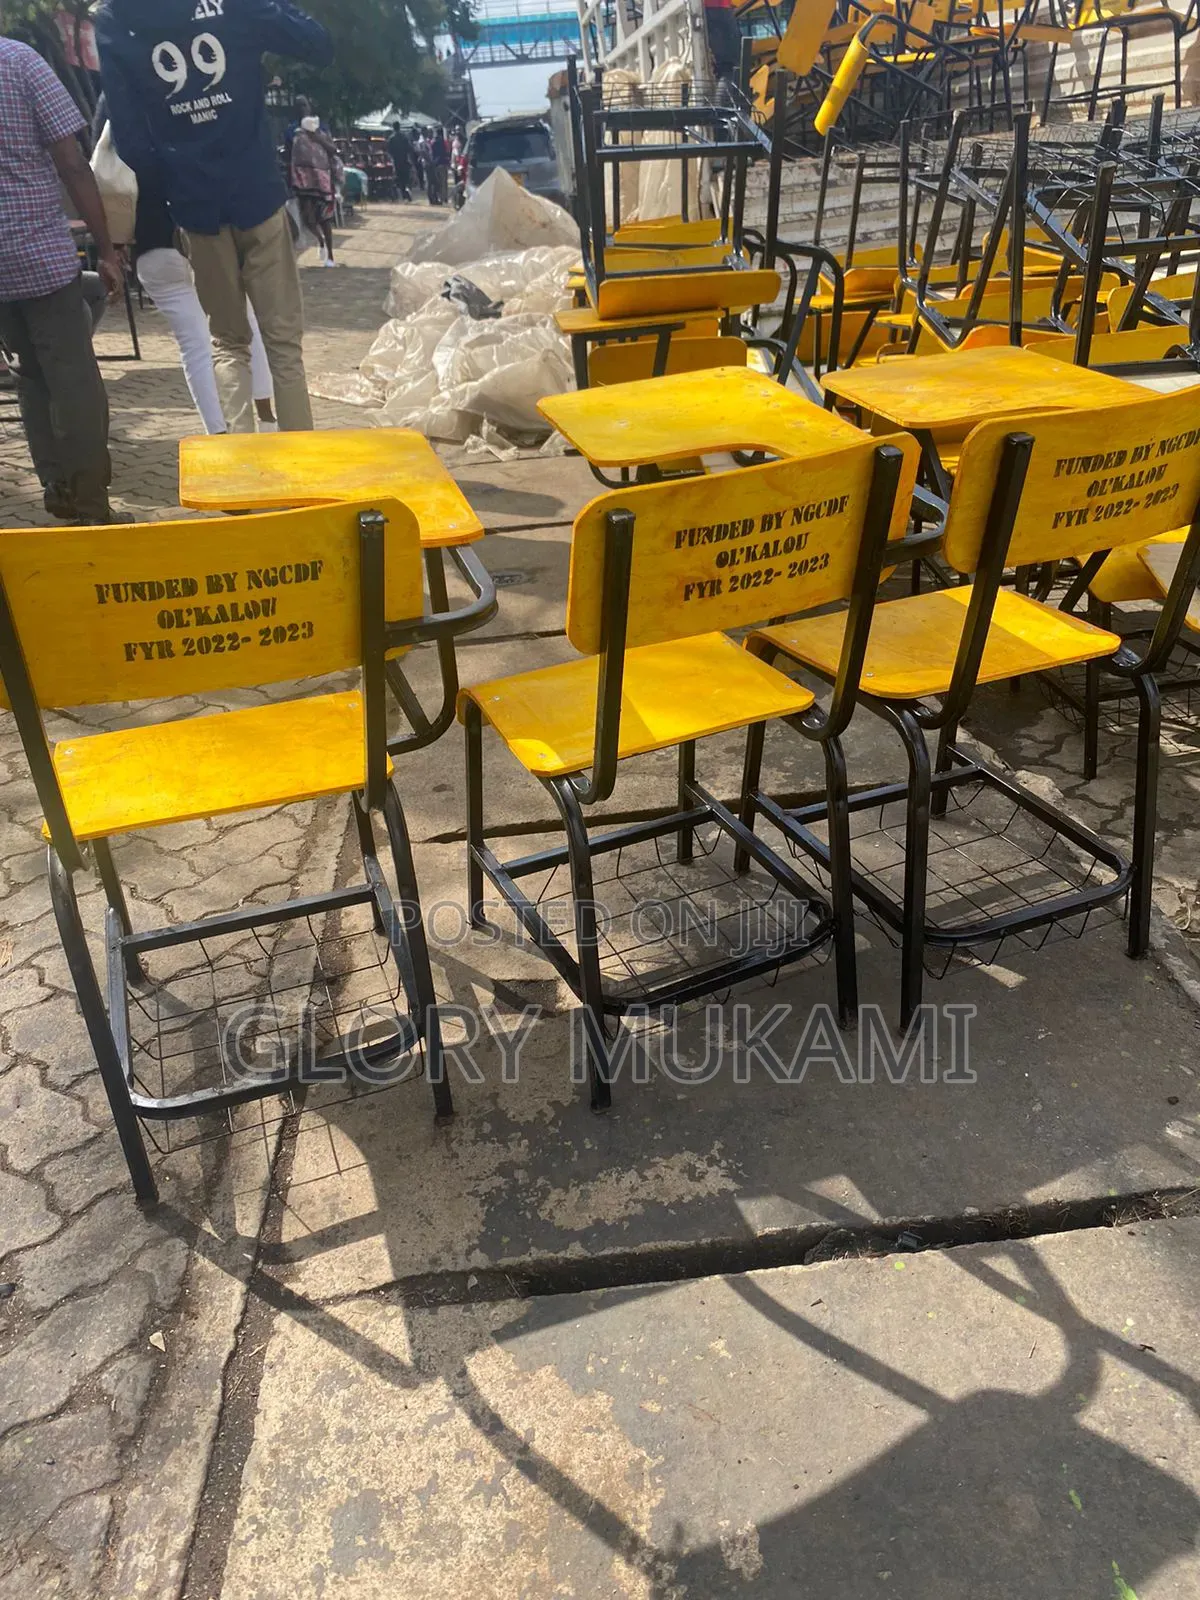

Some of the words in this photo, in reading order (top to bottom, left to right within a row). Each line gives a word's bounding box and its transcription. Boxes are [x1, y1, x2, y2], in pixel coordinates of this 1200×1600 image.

[170, 101, 193, 115] ROCK
[193, 97, 211, 110] AND
[210, 92, 232, 107] ROLL
[190, 109, 218, 124] MANIC
[1053, 450, 1128, 478] FUNDED
[1129, 442, 1155, 465] BY
[1086, 463, 1168, 498] OL'KALOU
[674, 518, 755, 549] FUNDED
[759, 510, 787, 533] BY
[790, 495, 850, 526] NGCDF
[1052, 508, 1089, 529] FYR
[1143, 483, 1180, 509] 2023
[715, 532, 811, 568] OL'KALOU
[94, 577, 199, 605] FUNDED
[205, 572, 238, 595] BY
[246, 559, 324, 590] NGCDF
[683, 578, 723, 601] FYR
[787, 552, 830, 579] 2023
[156, 597, 278, 630] OL'KALOU
[123, 639, 176, 662] FYR
[258, 621, 315, 647] 2023
